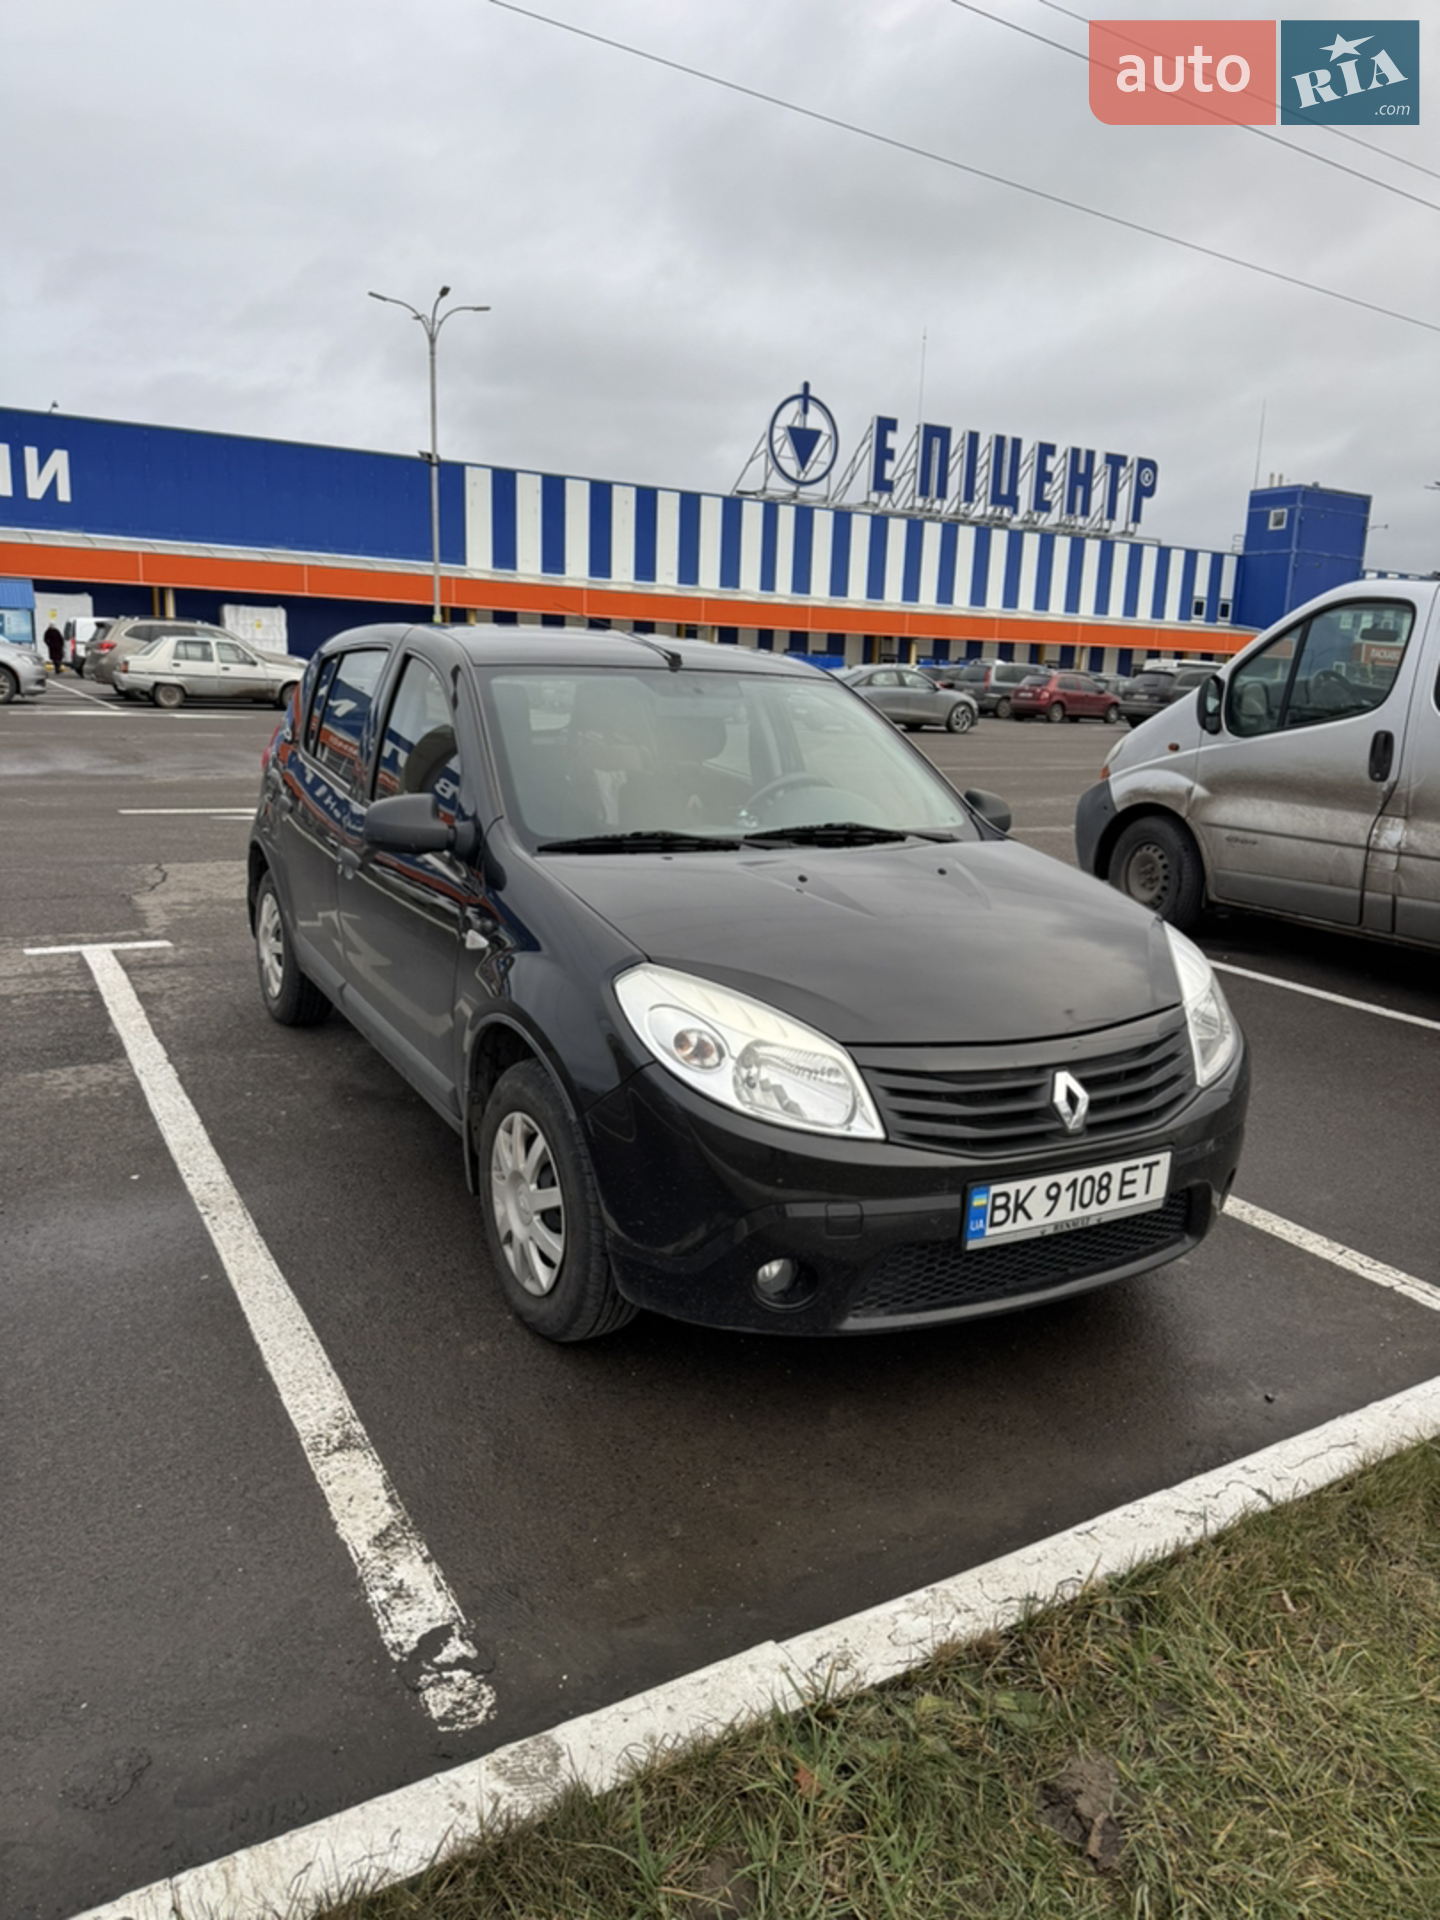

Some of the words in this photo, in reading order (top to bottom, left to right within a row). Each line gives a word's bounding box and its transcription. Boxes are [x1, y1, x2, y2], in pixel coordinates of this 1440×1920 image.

[871, 414, 1159, 525] ЕПІЦЕНТР
[969, 1218, 985, 1231] UA
[987, 1185, 1037, 1229] BK
[1043, 1171, 1113, 1218] 9108
[1117, 1159, 1161, 1202] ET
